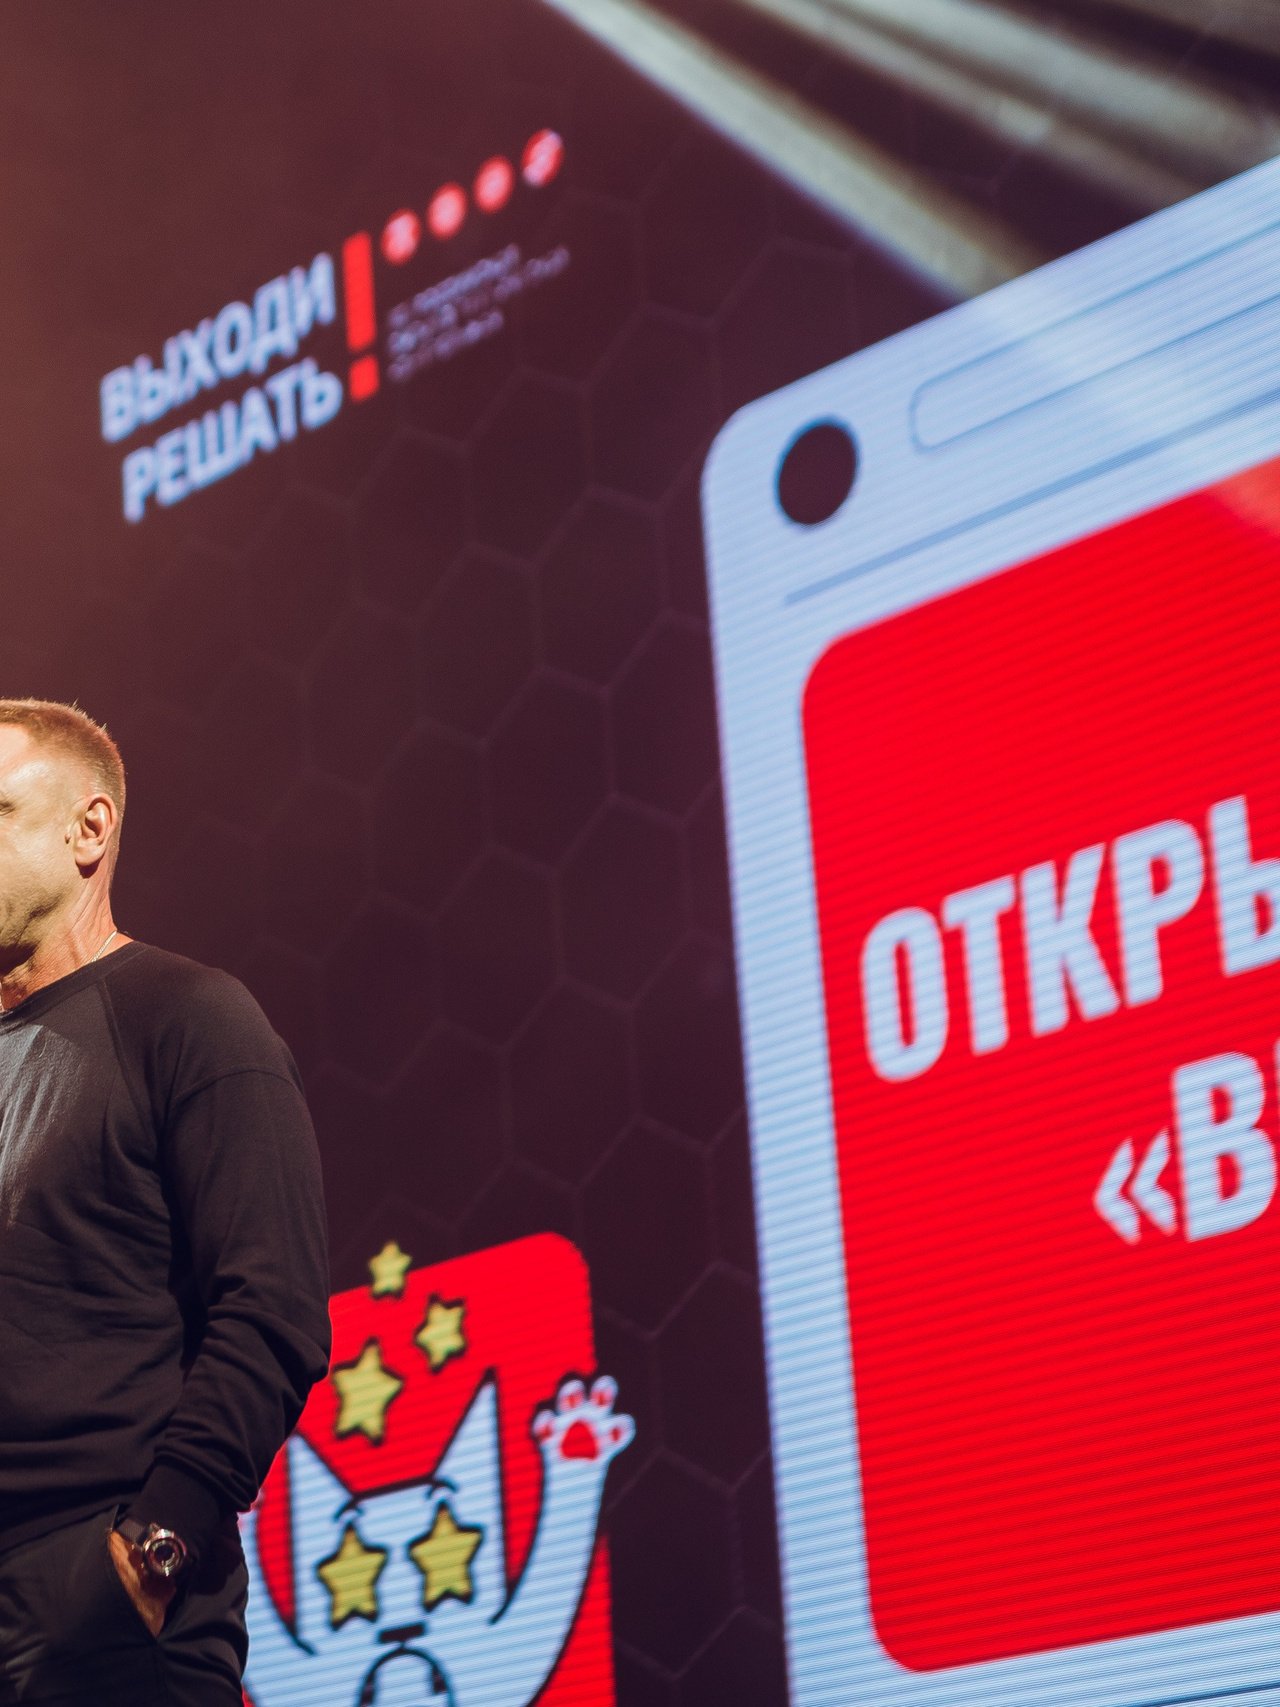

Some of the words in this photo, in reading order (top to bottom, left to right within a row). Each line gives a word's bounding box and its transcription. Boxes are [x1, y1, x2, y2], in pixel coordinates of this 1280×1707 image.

[100, 252, 337, 444] ВЫХОДИ
[122, 356, 344, 524] РЕШАТЬ
[1093, 1038, 1280, 1246] «В
